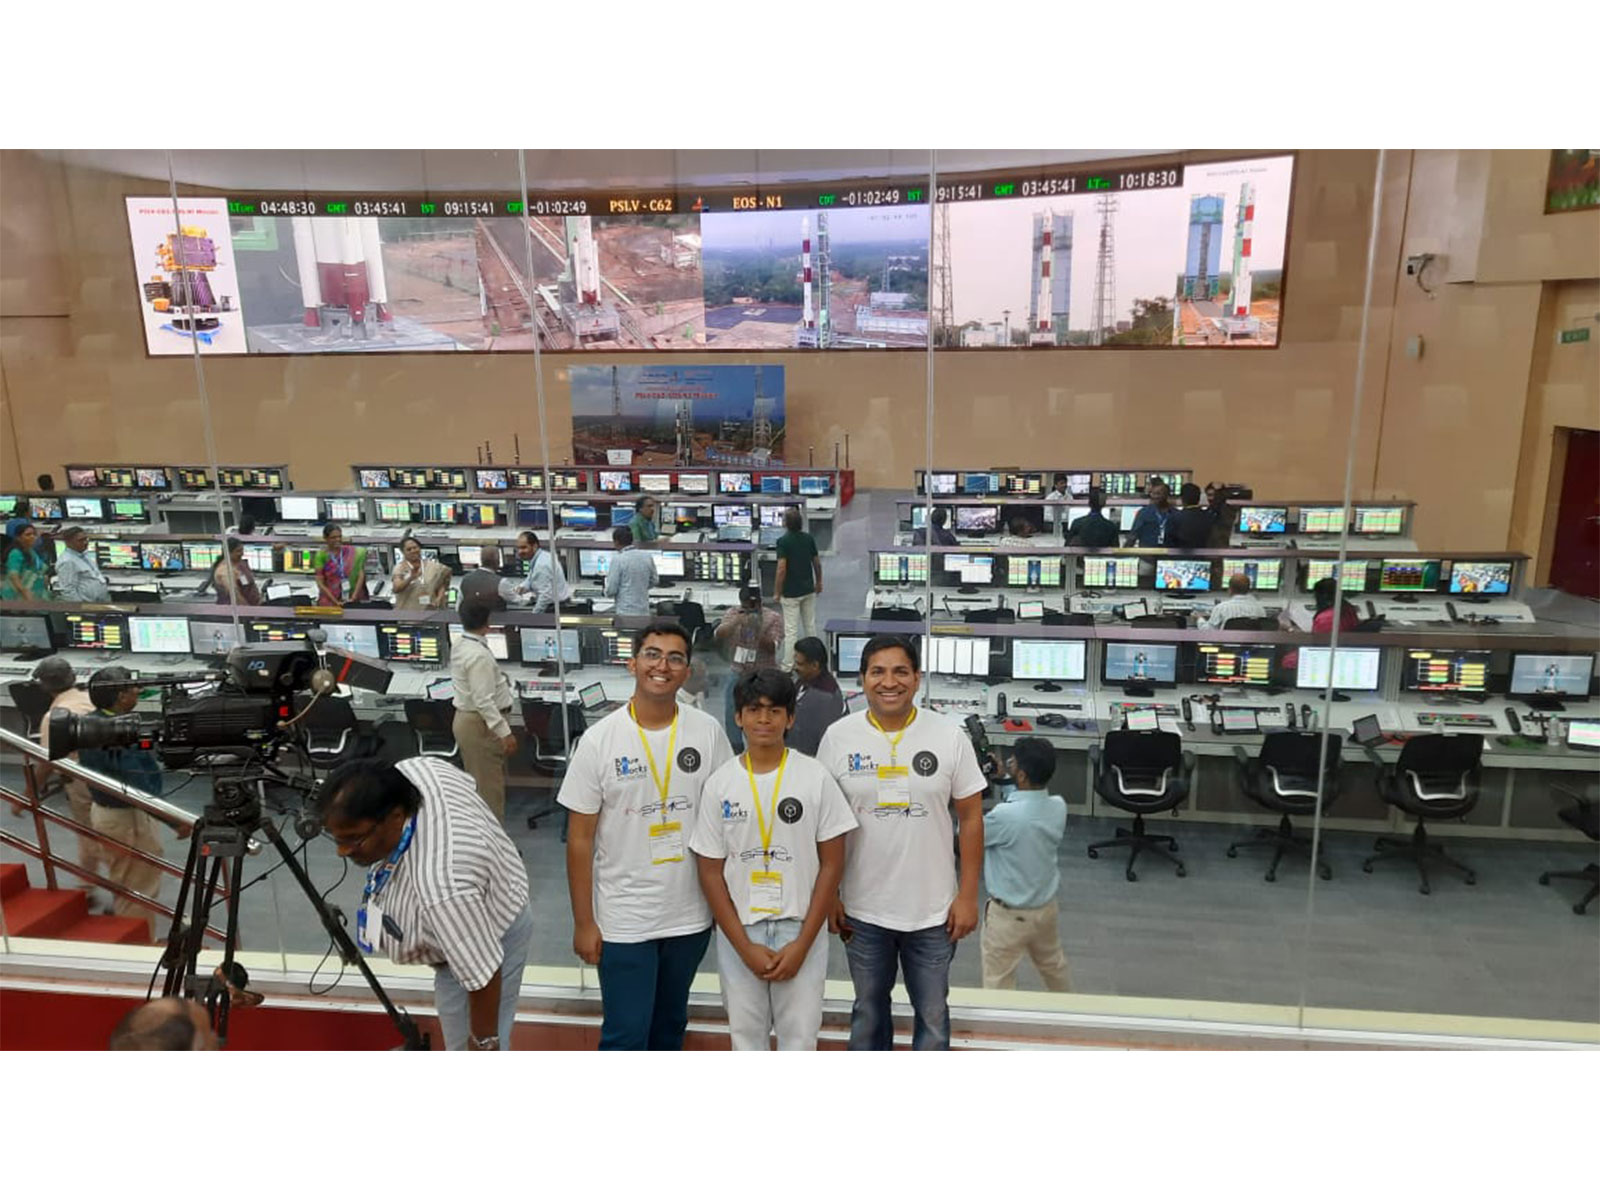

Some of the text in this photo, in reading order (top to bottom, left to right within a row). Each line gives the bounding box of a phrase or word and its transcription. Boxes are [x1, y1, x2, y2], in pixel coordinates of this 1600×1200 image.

[1119, 171, 1177, 188] 10:18:30
[842, 189, 900, 206] -01:02:49
[1022, 178, 1076, 196] 03:45:41
[260, 201, 316, 215] 04:48:30
[354, 202, 406, 215] 03:45:41
[444, 202, 494, 215] 09:15:41
[530, 201, 587, 214] -01:02:49
[609, 200, 640, 213] PSLV
[649, 200, 673, 212] C62
[732, 197, 756, 209] EOS
[766, 196, 783, 208] N1
